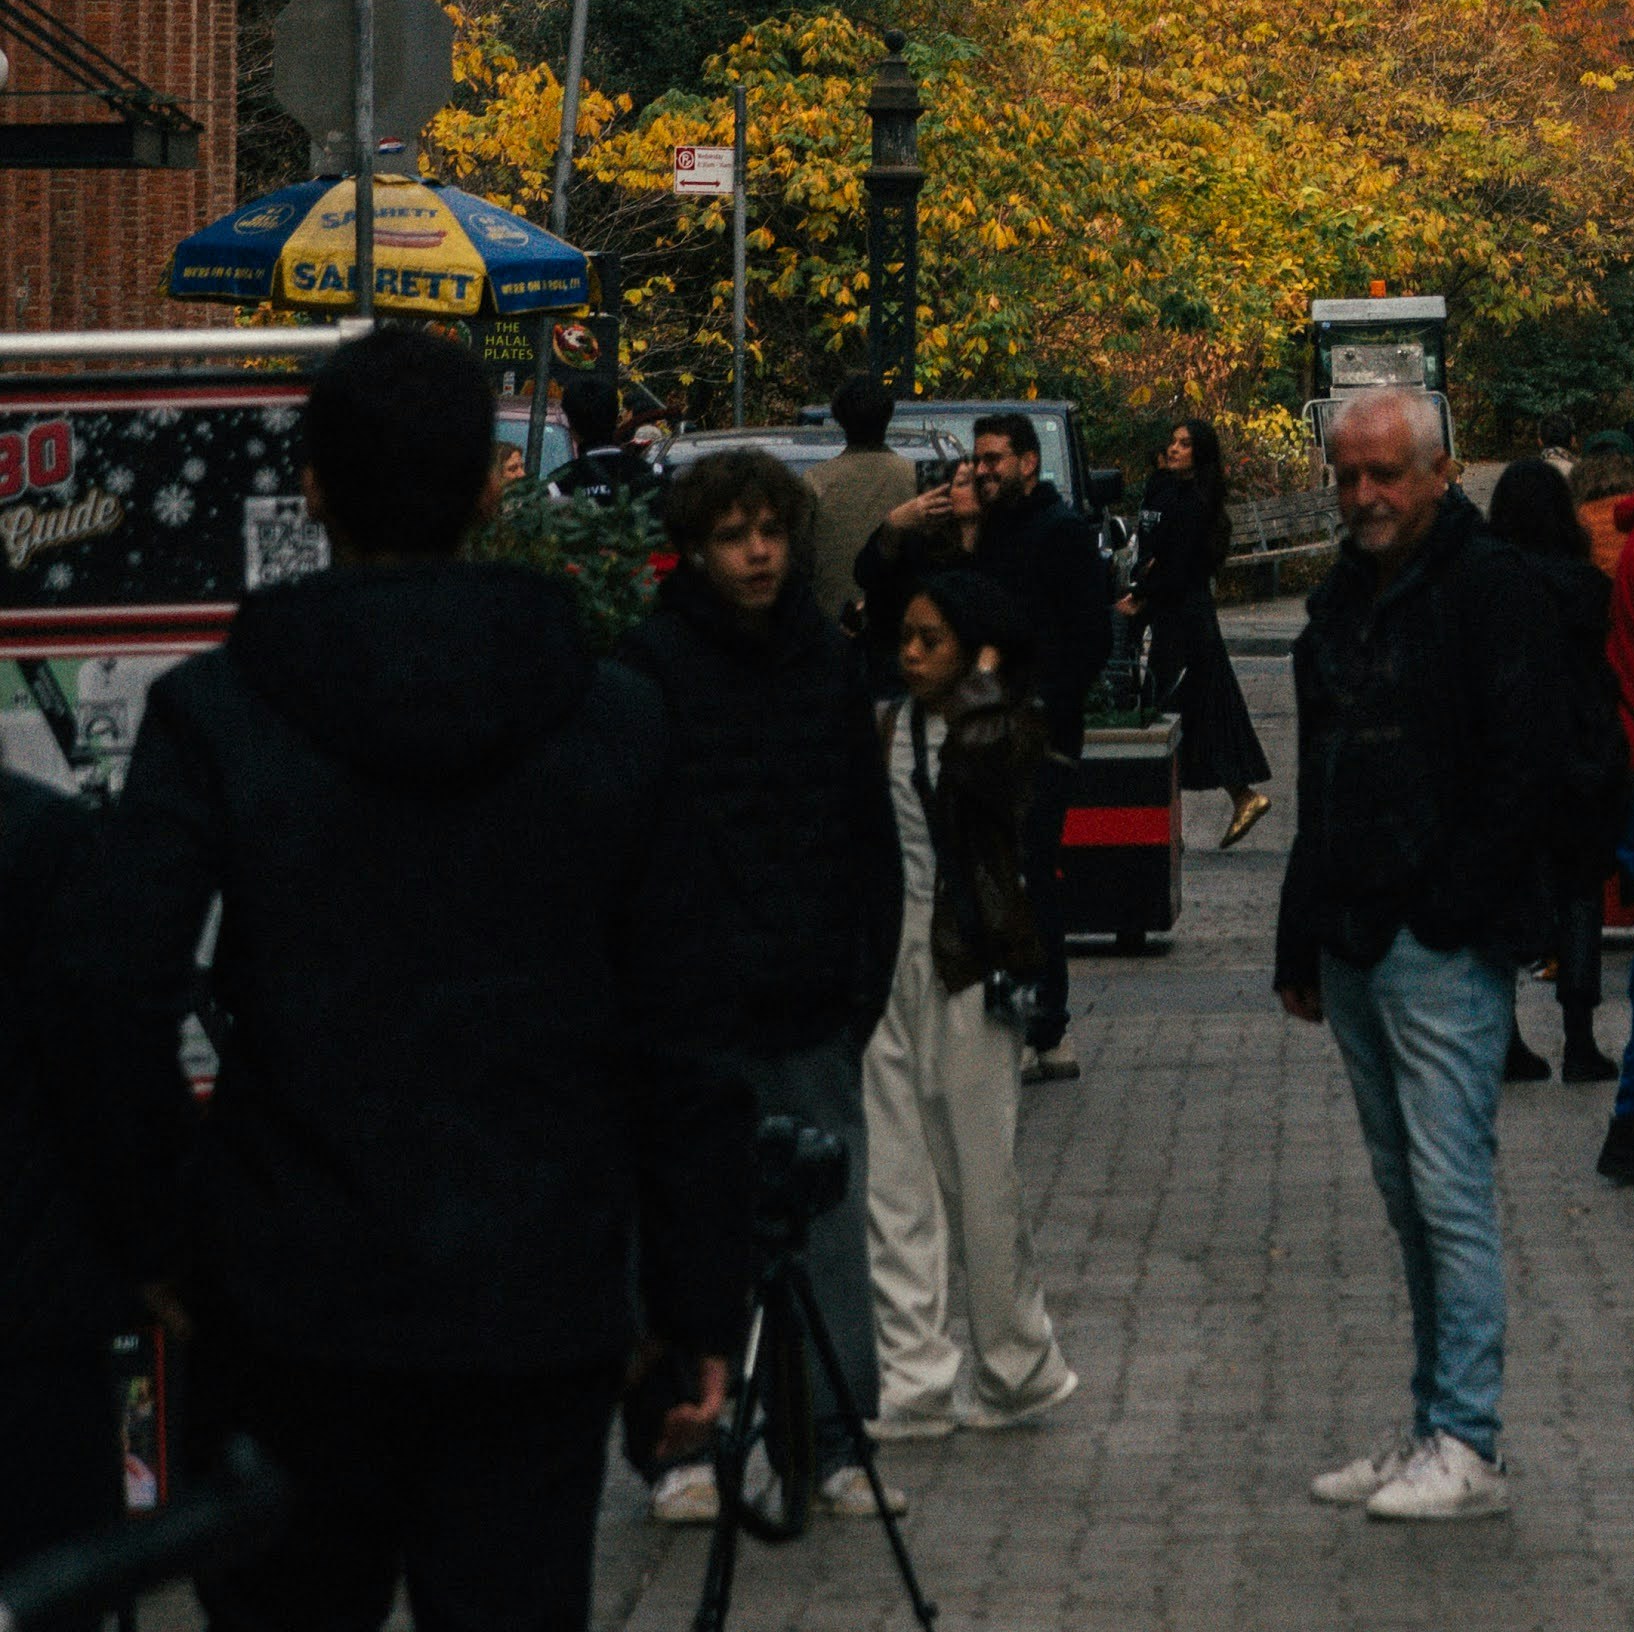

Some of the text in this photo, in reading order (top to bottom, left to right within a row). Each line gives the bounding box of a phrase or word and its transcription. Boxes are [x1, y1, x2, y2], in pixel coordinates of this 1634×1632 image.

[495, 321, 520, 334] THE
[484, 335, 530, 348] HALAL
[484, 348, 534, 361] PLATES
[1, 488, 118, 567] Guide
